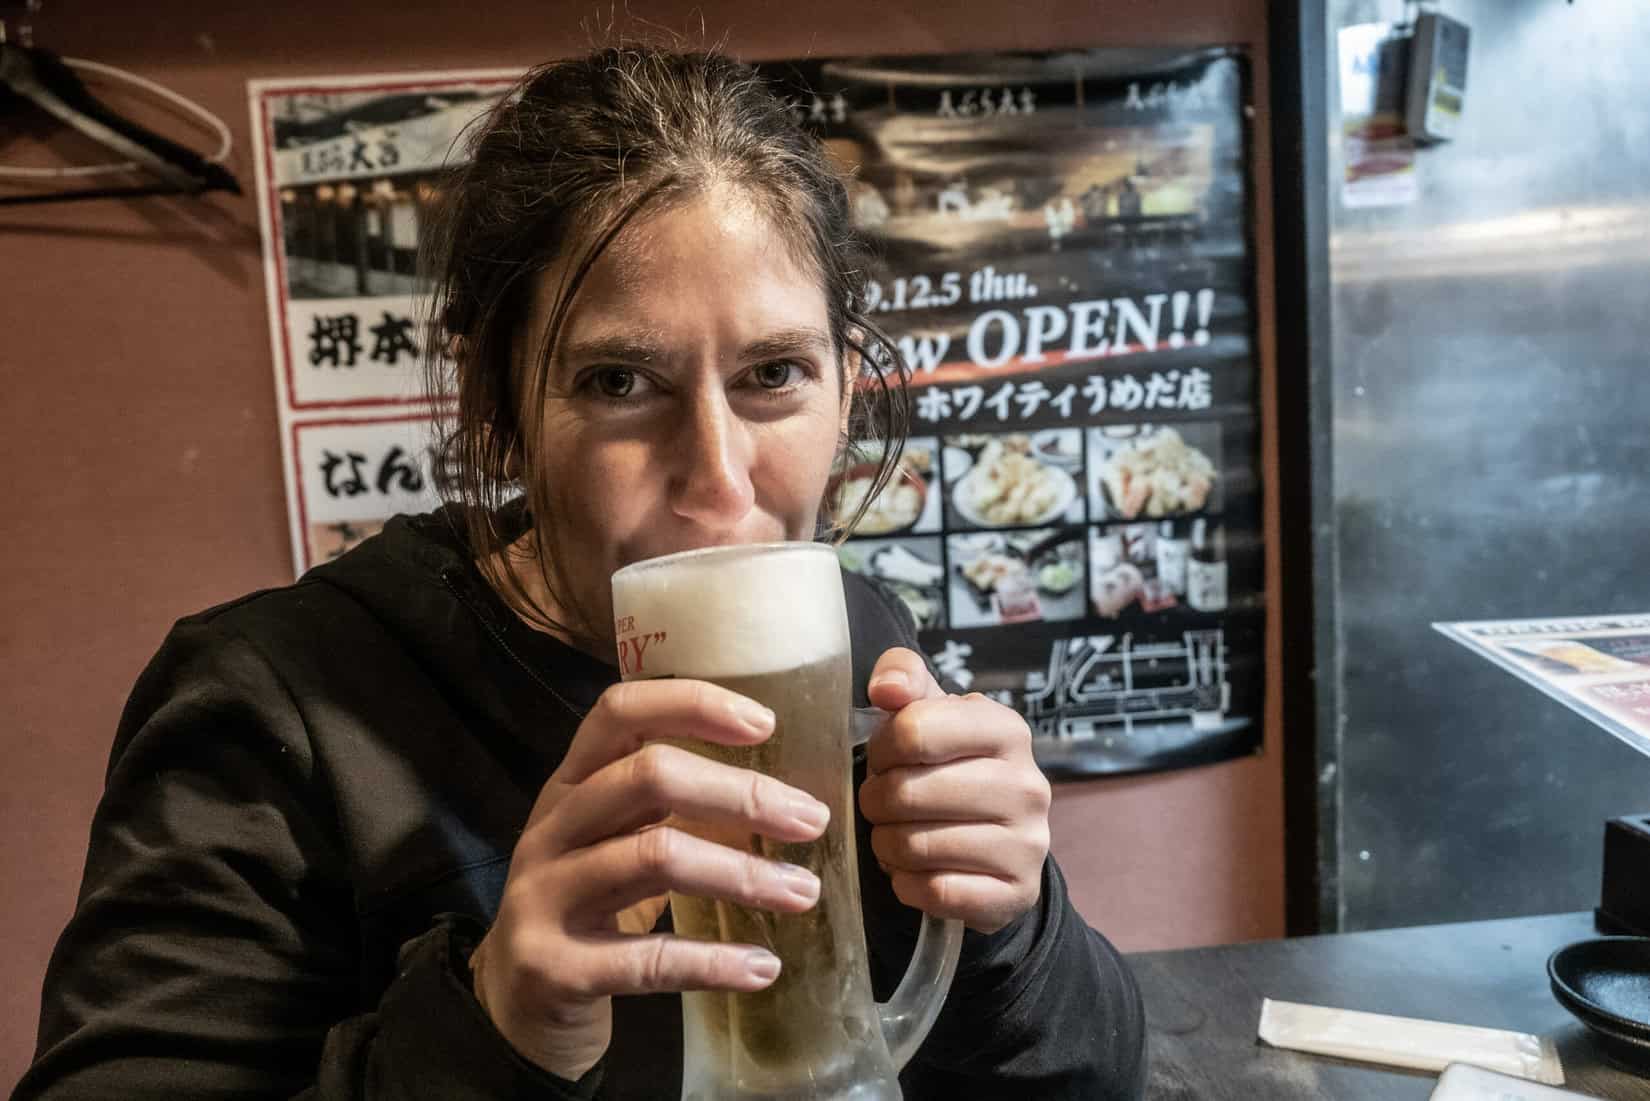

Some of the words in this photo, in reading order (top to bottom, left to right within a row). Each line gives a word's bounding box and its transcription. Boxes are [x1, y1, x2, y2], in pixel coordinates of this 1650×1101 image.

[847, 271, 962, 311] 9.12.5
[970, 266, 1038, 303] thu.
[967, 289, 1216, 369] OPEN!!
[917, 367, 1213, 422] ホワイティうめだ店
